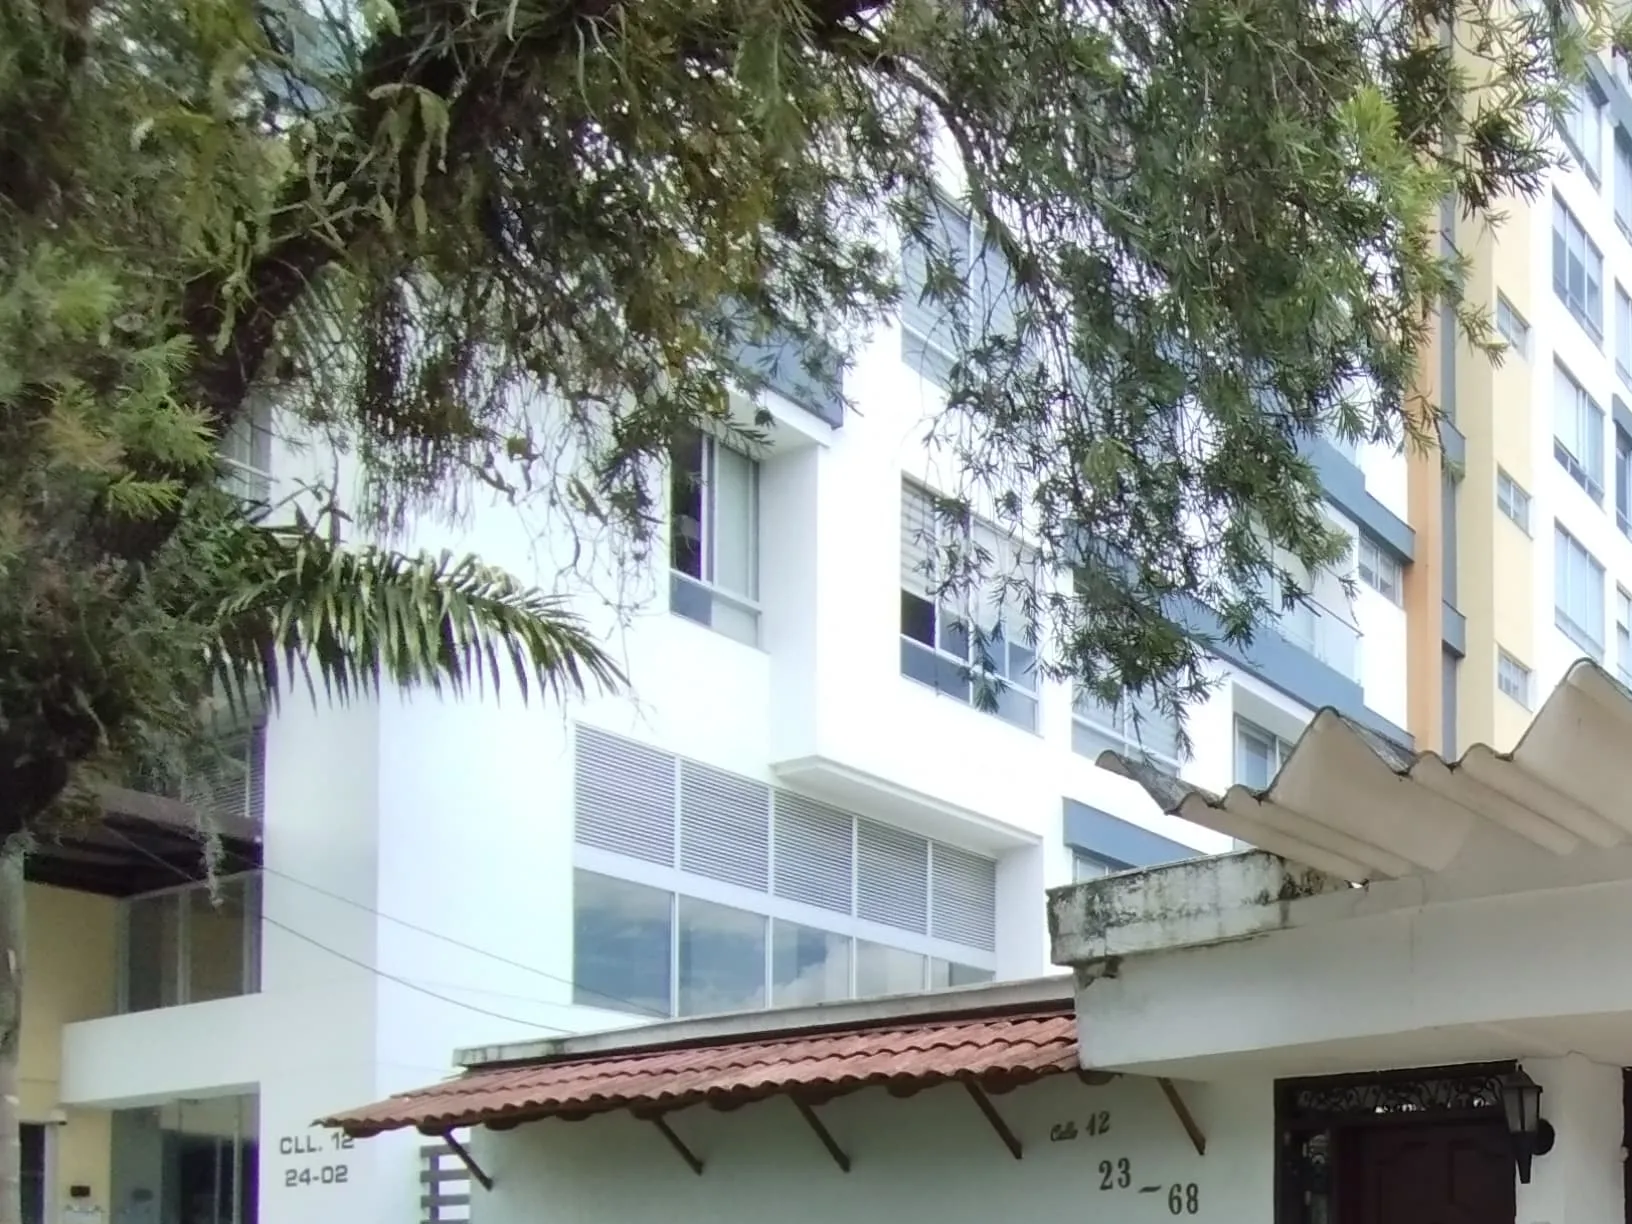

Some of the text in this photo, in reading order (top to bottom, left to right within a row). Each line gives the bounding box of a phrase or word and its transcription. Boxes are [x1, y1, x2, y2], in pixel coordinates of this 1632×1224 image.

[1086, 1110, 1110, 1137] 12
[280, 1135, 322, 1155] CLL.
[285, 1164, 349, 1187] 24-02
